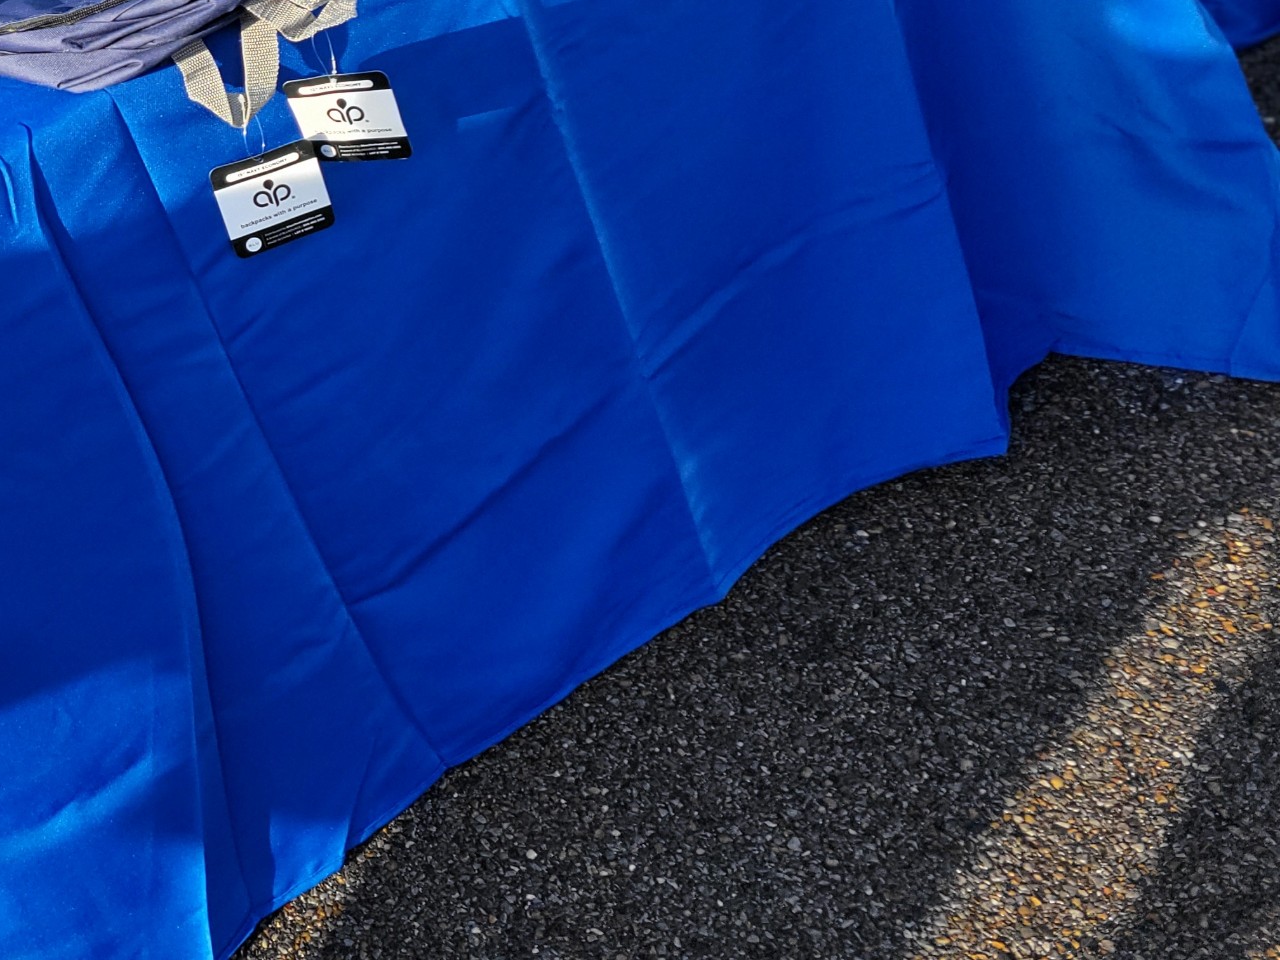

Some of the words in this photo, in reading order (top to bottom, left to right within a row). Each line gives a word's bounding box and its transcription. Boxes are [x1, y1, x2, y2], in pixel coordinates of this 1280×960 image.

[240, 214, 272, 229] backpacks
[273, 208, 286, 217] with
[292, 198, 318, 211] purpose
